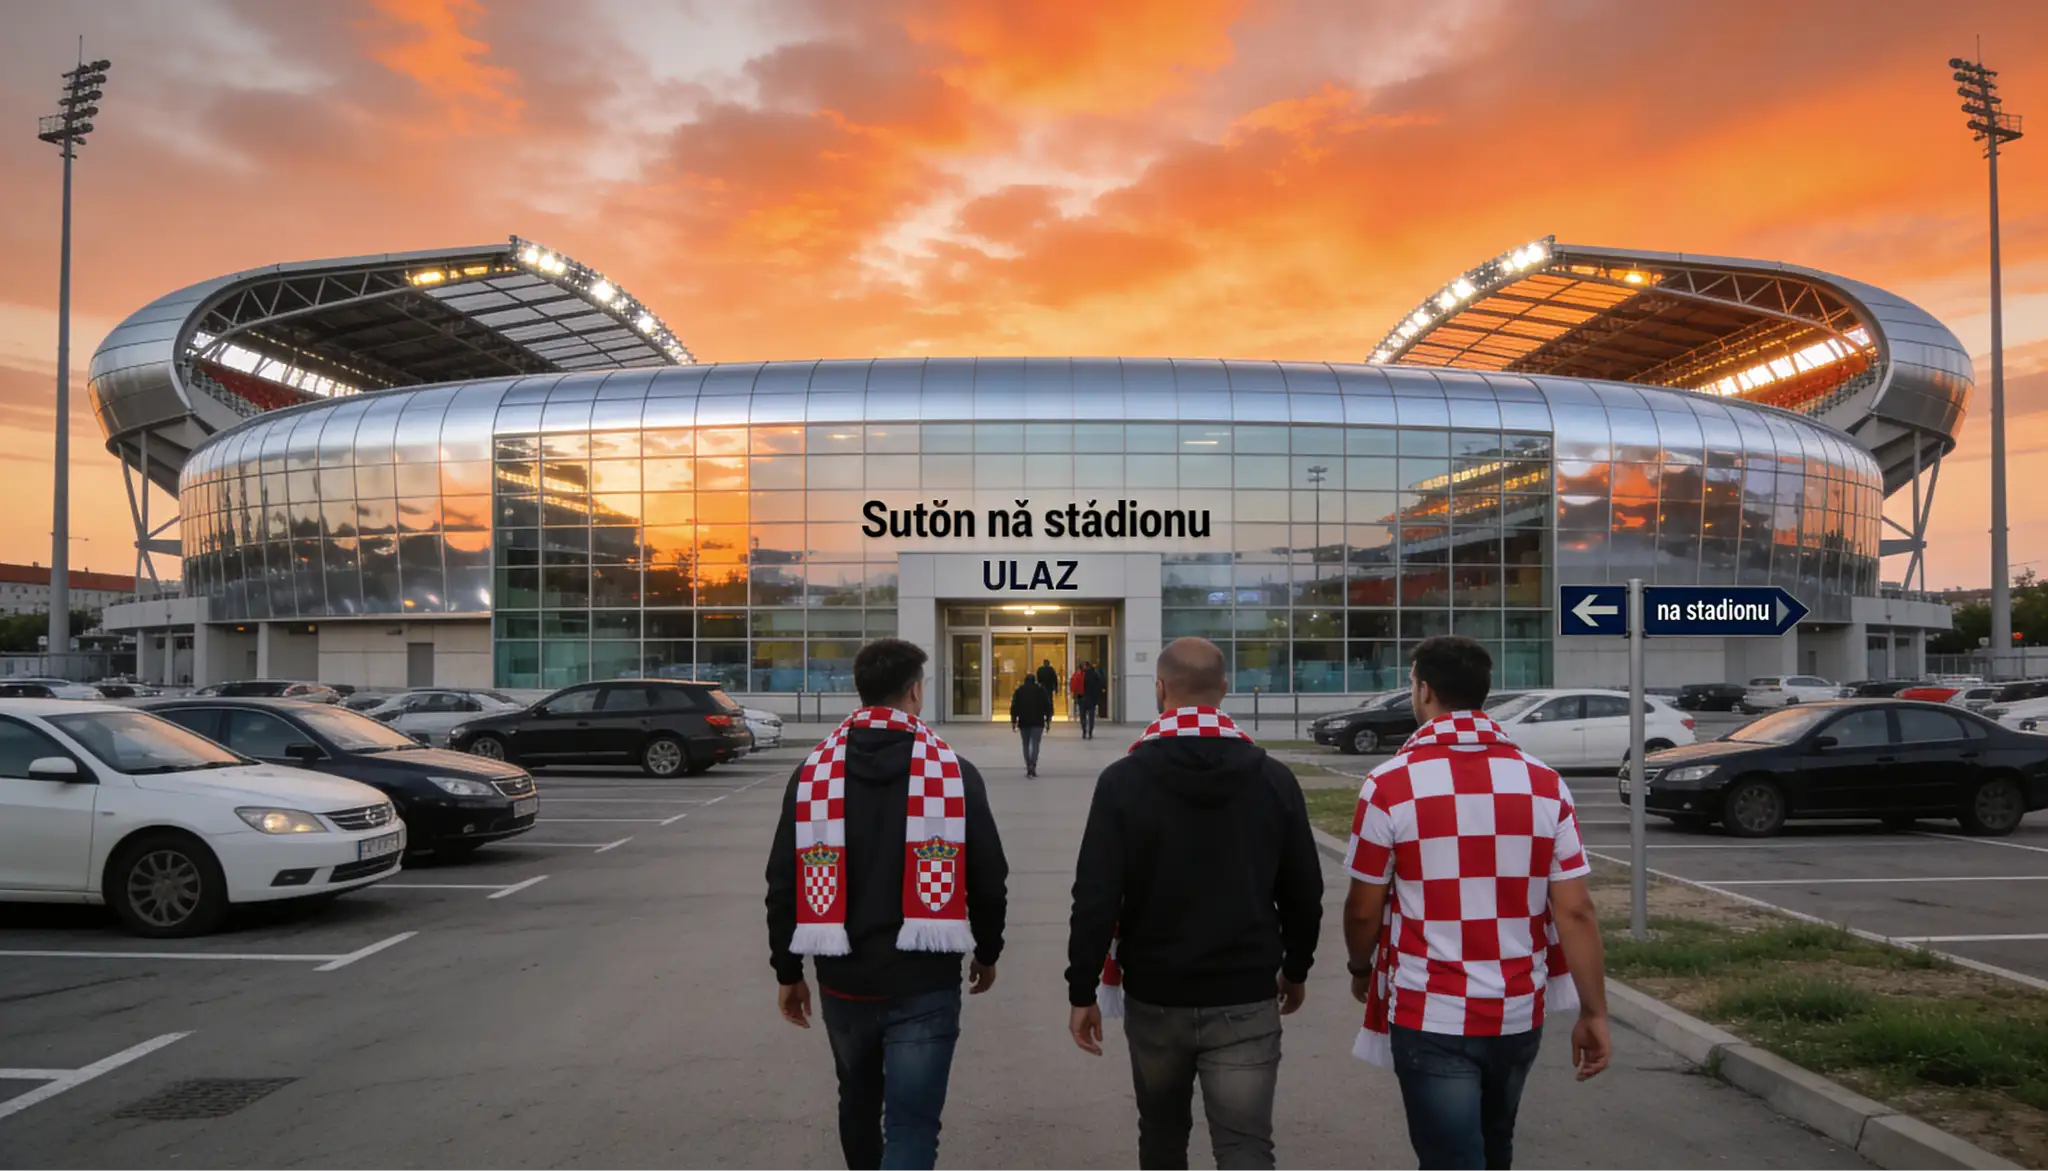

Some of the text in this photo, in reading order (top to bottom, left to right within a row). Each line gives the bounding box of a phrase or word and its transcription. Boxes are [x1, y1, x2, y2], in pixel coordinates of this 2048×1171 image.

[983, 560, 1078, 591] ULAZ
[1657, 598, 1769, 621] na stadionu
